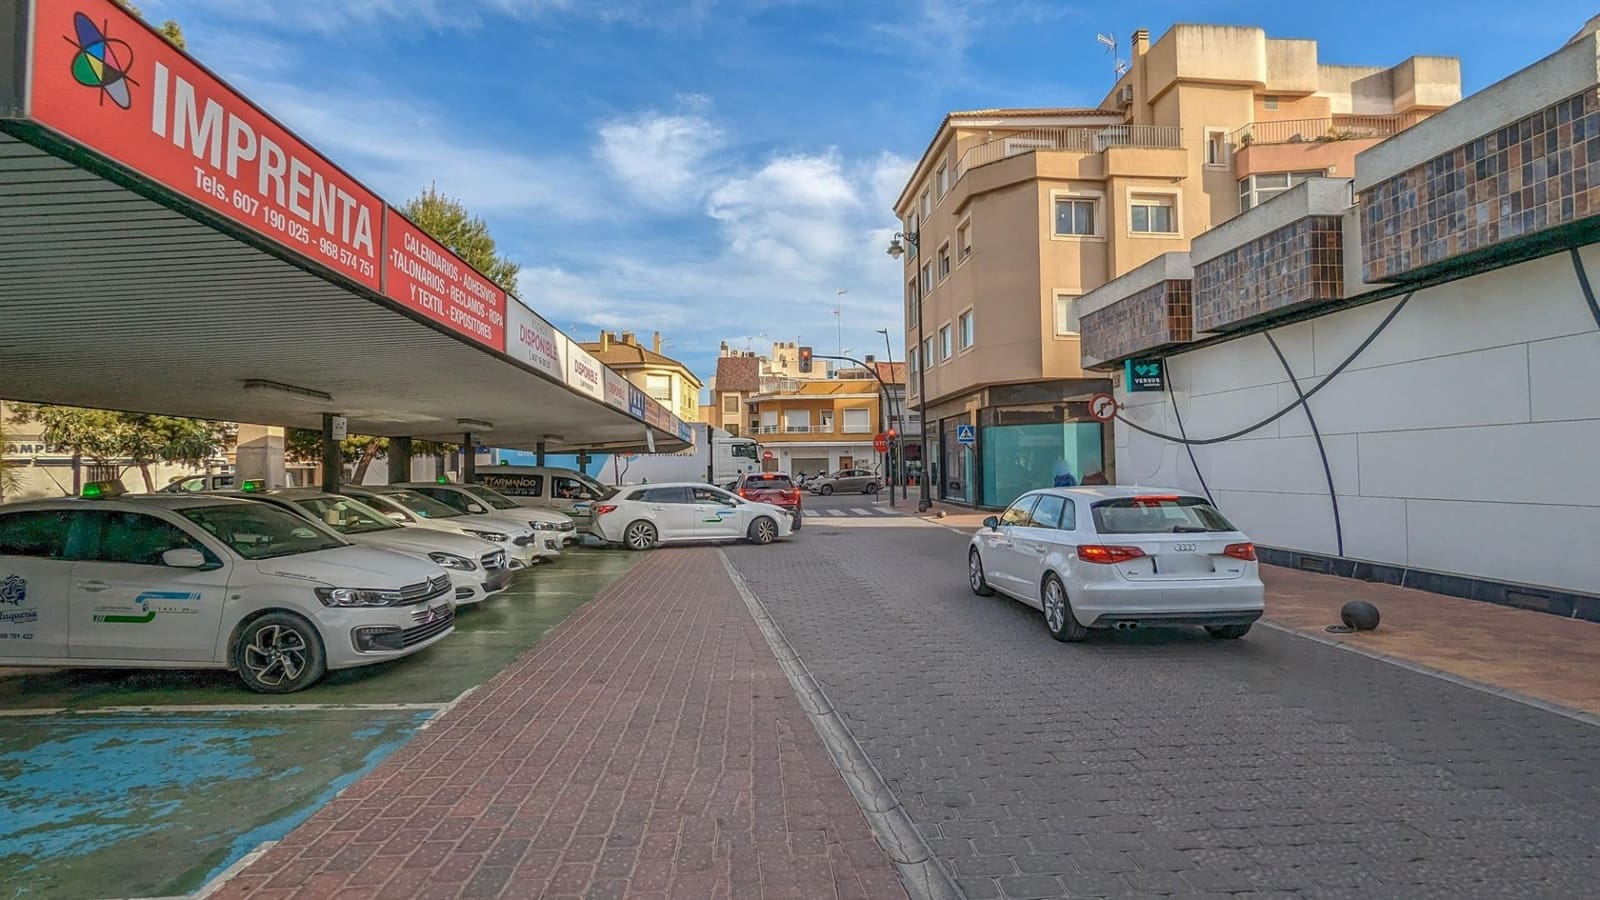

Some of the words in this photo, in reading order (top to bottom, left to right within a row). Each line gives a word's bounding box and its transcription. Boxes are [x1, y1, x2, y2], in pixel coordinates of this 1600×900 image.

[152, 61, 374, 257] IMPRENTA
[194, 166, 229, 202] Tels.
[233, 190, 259, 217] 607
[263, 206, 285, 231] 190
[288, 220, 310, 244] 025
[320, 237, 338, 260] 968
[340, 248, 357, 269] 574
[359, 258, 374, 278] 751
[404, 232, 459, 282] CALENDARIOS
[463, 273, 497, 306] ADHESIVOS
[410, 283, 416, 301] Y
[418, 287, 445, 316] TEXTIL
[450, 305, 492, 339] EXPOSITORES
[450, 285, 485, 318] RECLAMOS
[489, 308, 504, 328] ROPA
[520, 323, 557, 361] DISPONIBLE
[574, 359, 598, 385] DISPONIBLE
